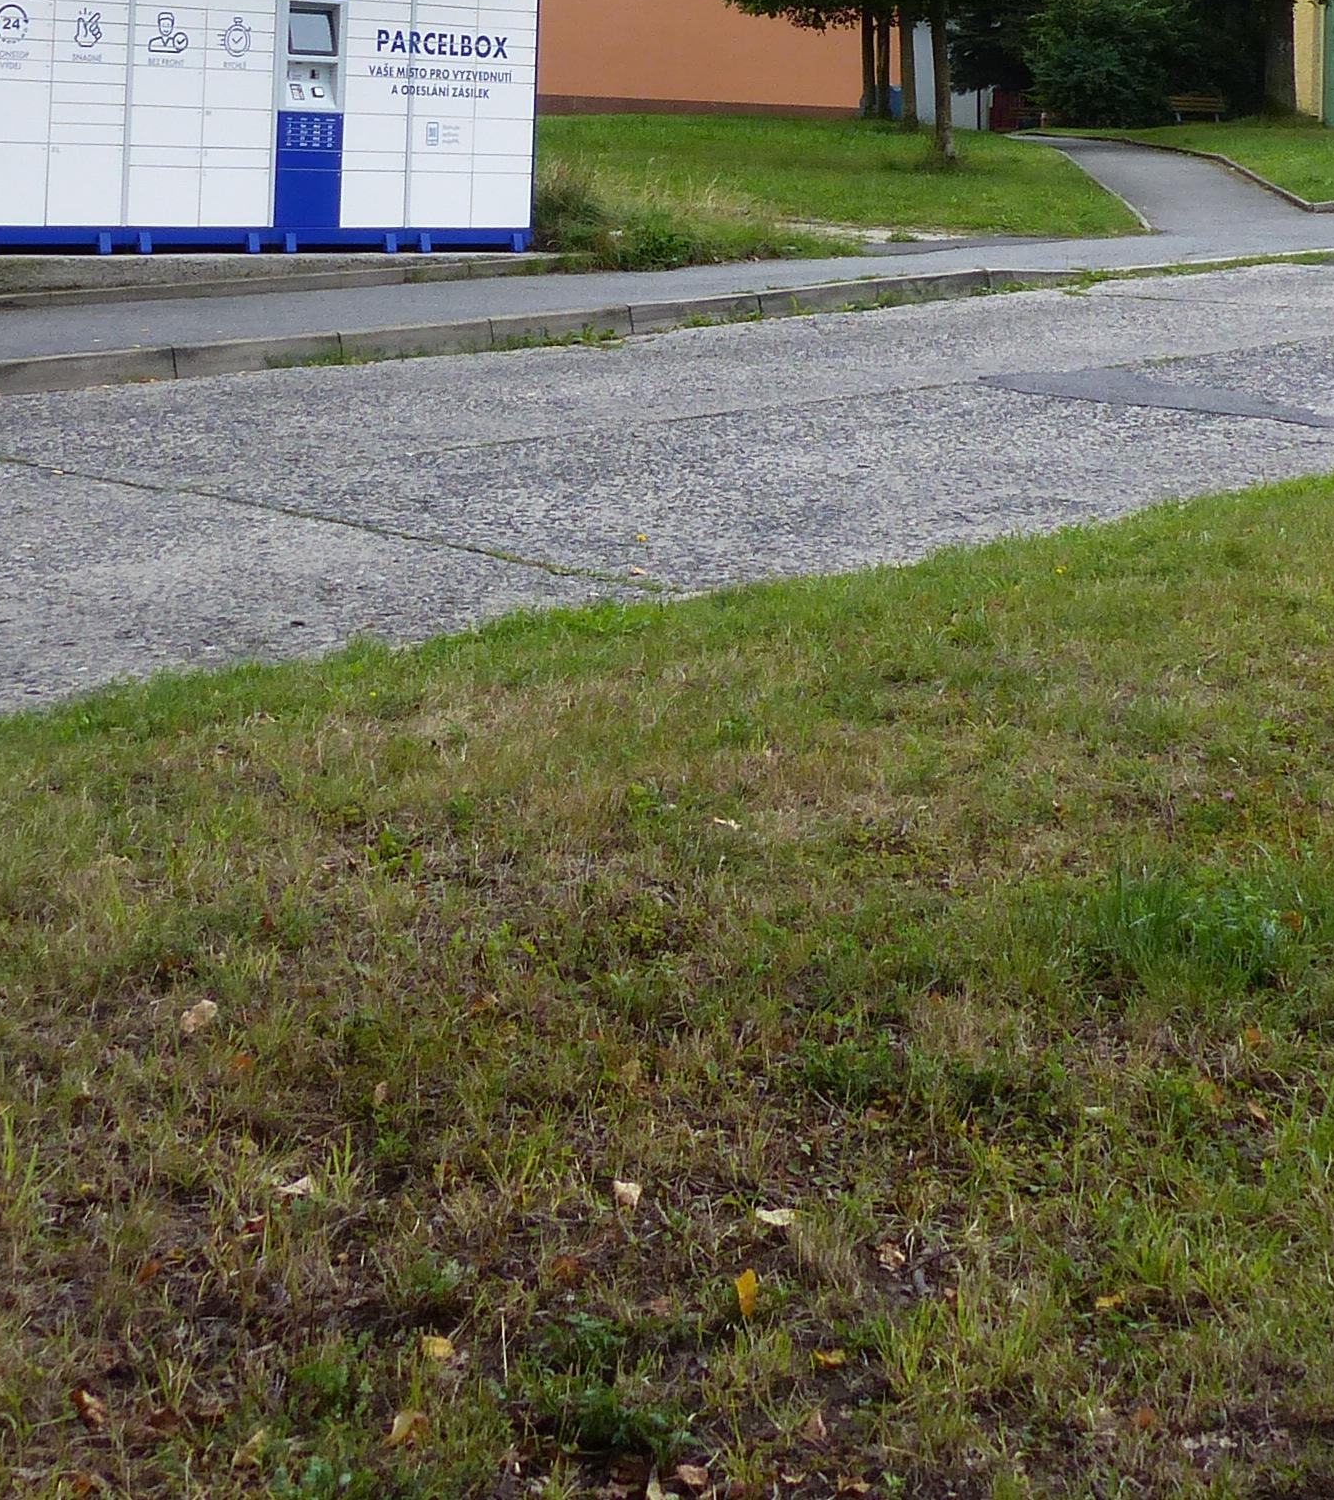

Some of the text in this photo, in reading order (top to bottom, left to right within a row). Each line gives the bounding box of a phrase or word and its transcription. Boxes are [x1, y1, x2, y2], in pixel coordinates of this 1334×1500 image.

[2, 18, 21, 30] 24
[376, 29, 508, 59] PARCELBOX
[369, 63, 395, 77] VAŠE
[430, 69, 450, 80] PRO
[452, 69, 512, 83] VYZVEDNUTÍ
[391, 84, 490, 99] A ODESLÁNÍ ZÁSILEK
